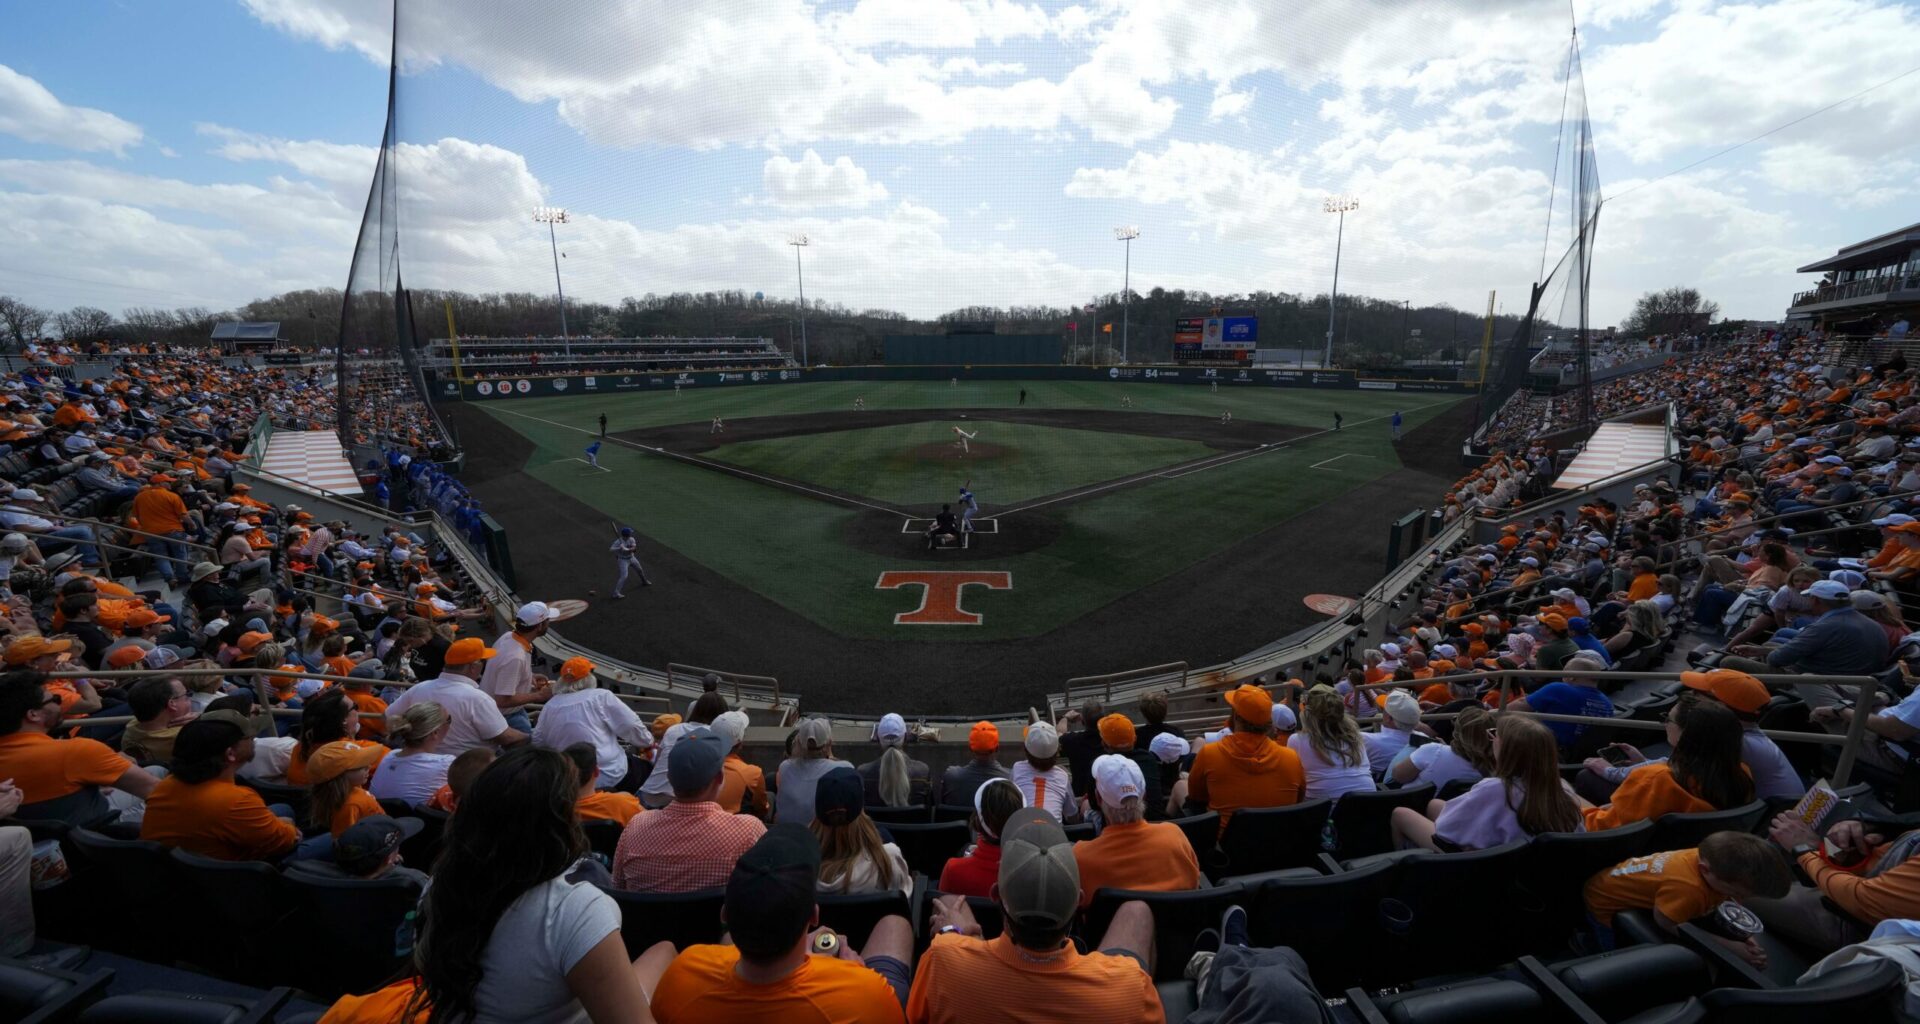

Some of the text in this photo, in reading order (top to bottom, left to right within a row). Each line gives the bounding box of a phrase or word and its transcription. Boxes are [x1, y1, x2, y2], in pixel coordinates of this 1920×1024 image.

[718, 373, 726, 382] 7
[1145, 369, 1158, 378] 54
[875, 570, 1013, 626] T
[1033, 776, 1047, 809] 1
